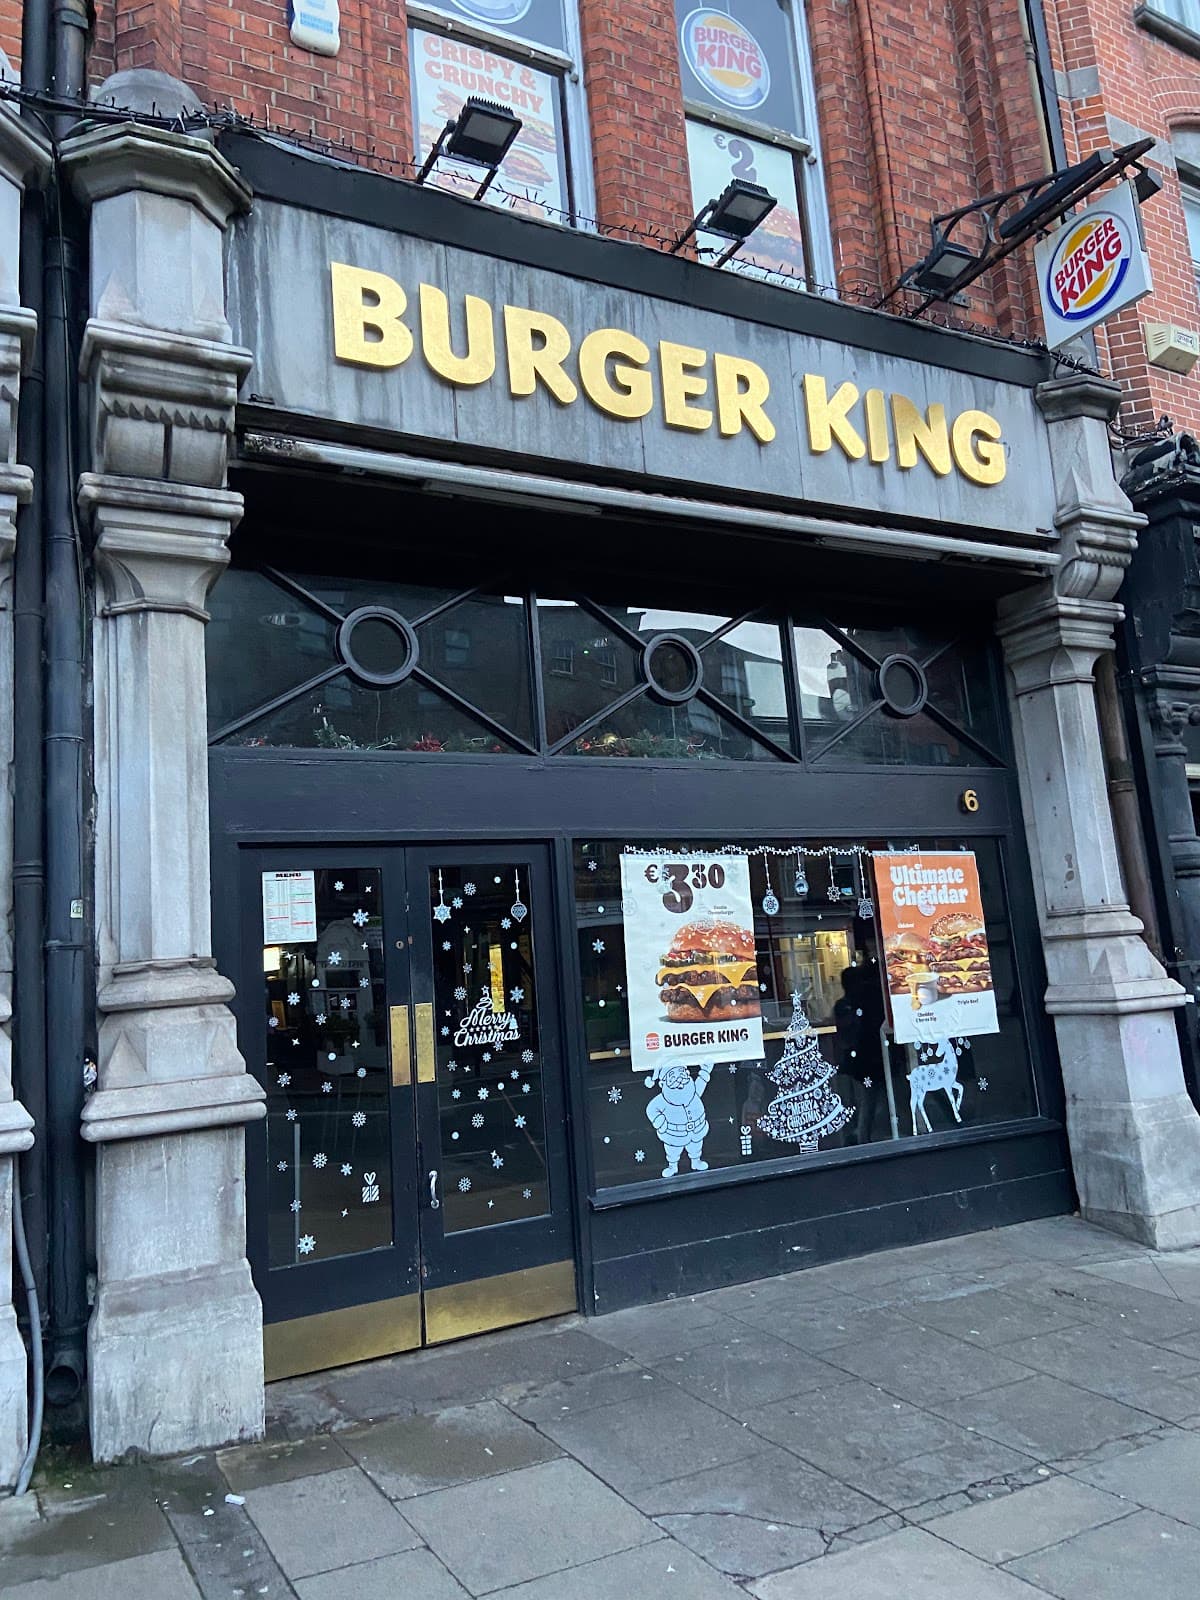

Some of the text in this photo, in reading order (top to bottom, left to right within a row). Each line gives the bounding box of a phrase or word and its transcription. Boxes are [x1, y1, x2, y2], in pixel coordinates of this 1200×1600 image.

[693, 25, 760, 56] BURGER
[423, 36, 537, 91] CRISPY &
[696, 42, 763, 80] KING
[424, 59, 544, 112] CRUNCHY
[1054, 217, 1114, 292] BURGER
[1058, 231, 1123, 315] KING
[330, 261, 1007, 485] BURGER KING
[964, 789, 980, 812] 6
[890, 864, 965, 885] Ultimate
[892, 886, 969, 906] Cheddar
[460, 1008, 512, 1030] Merry
[454, 1027, 521, 1047] Christmas
[663, 1028, 749, 1048] BURGER KING
[787, 1098, 813, 1116] MERRY
[787, 1110, 821, 1130] CHRISTMAS
